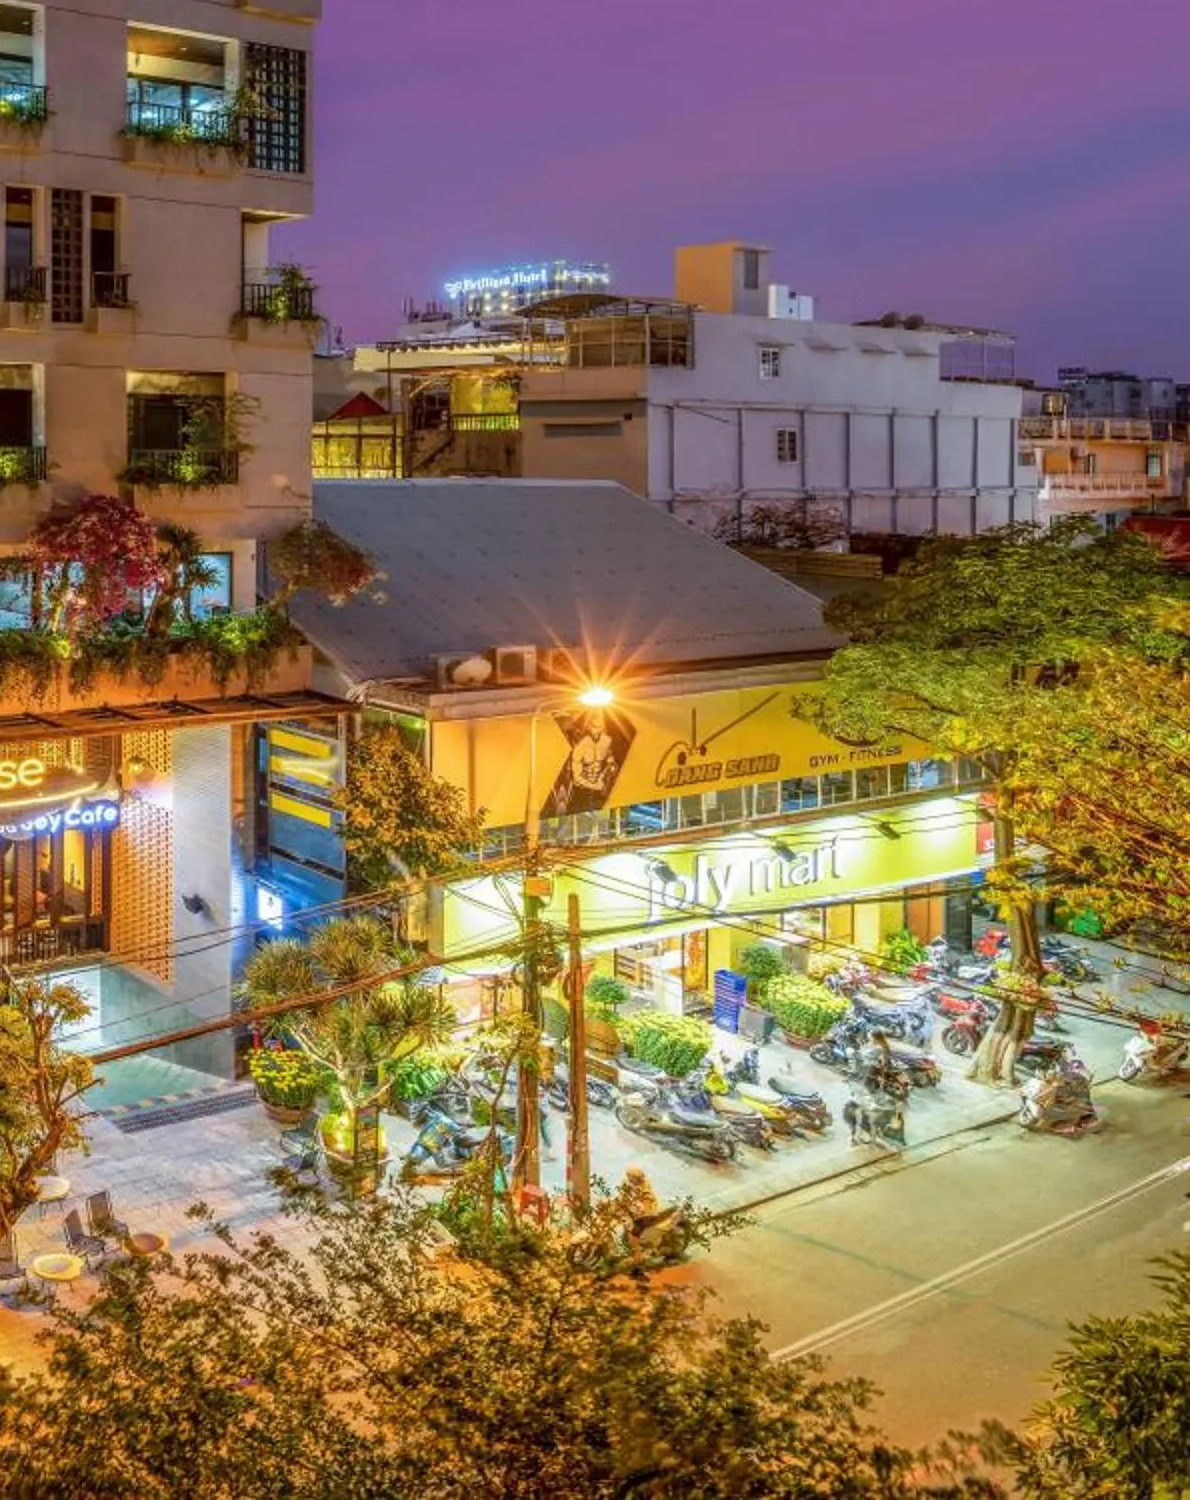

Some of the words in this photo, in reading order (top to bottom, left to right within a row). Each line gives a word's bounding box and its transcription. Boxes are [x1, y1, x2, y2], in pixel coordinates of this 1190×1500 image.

[809, 754, 839, 768] GYM
[849, 746, 903, 761] FITNESS
[64, 804, 117, 825] Cafe
[749, 835, 841, 896] mart
